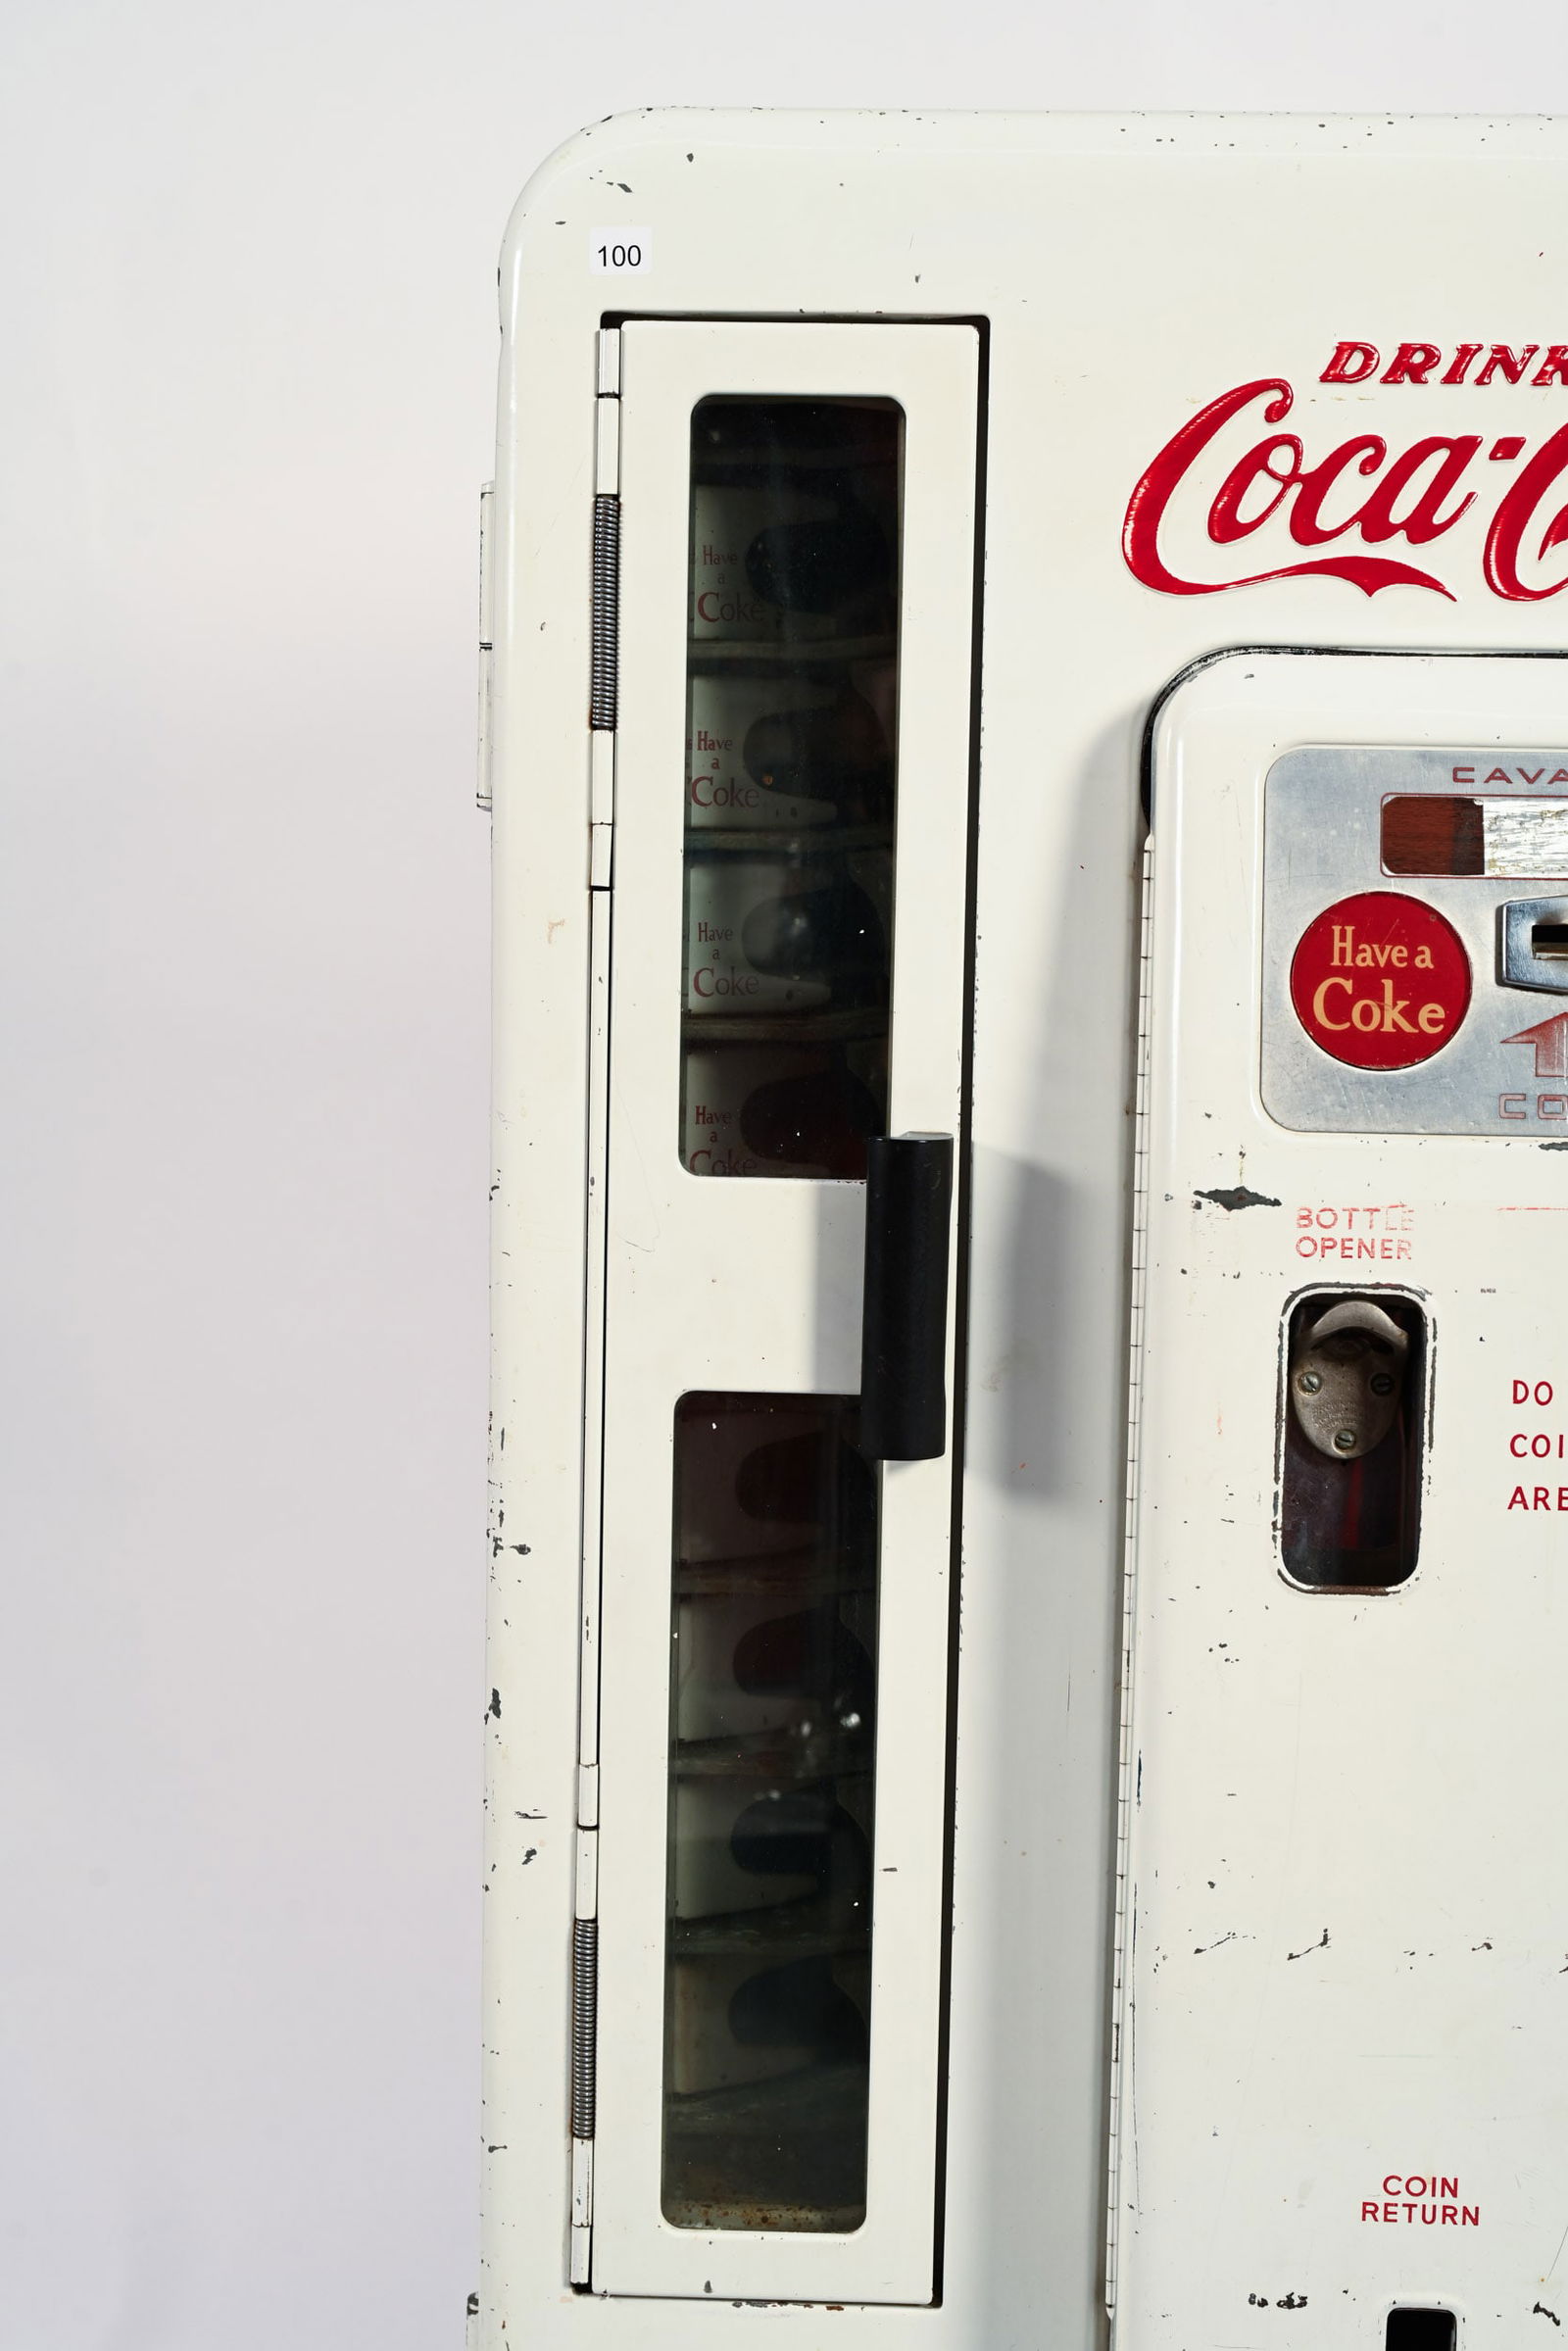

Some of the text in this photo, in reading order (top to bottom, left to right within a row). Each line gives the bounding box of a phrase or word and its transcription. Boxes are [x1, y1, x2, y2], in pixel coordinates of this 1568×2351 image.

[598, 244, 642, 267] 100
[1319, 341, 1568, 386] DRINK
[703, 544, 737, 565] Have
[716, 573, 726, 585] a
[697, 592, 764, 622] Coke
[697, 730, 733, 752] Have
[710, 759, 720, 769] a
[691, 776, 760, 807] Coke
[697, 921, 733, 943] Have
[711, 948, 720, 960] a
[1331, 925, 1435, 969] Have a
[693, 967, 760, 998] Coke
[1312, 977, 1446, 1034] Coke
[695, 1105, 732, 1126] Have
[1499, 1094, 1568, 1120] CO
[710, 1131, 718, 1144] a
[1296, 1206, 1414, 1231] BOTTLE
[1296, 1236, 1413, 1260] OPENER
[1512, 1379, 1553, 1406] DO
[1507, 1486, 1568, 1511] ARE
[1383, 2175, 1458, 2198] COIN
[1361, 2201, 1480, 2227] RETURN
